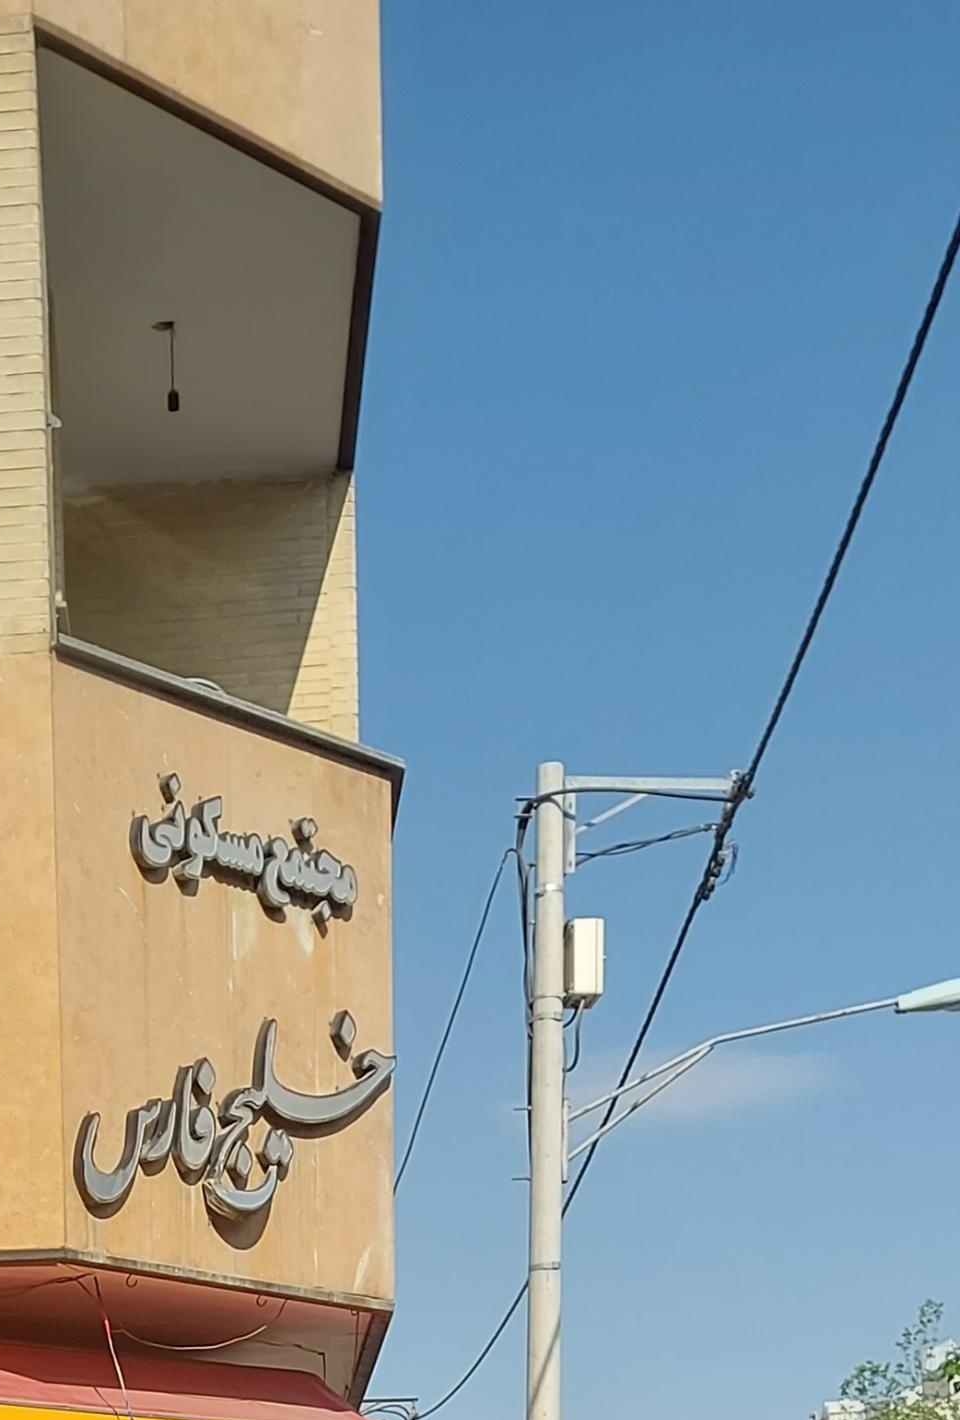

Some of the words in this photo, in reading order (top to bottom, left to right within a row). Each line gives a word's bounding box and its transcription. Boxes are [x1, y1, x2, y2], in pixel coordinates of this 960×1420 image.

[129, 772, 264, 897] مسکونی
[259, 817, 358, 937] مجتمع
[74, 1057, 216, 1218] فارس
[203, 1009, 398, 1222] خلیج
